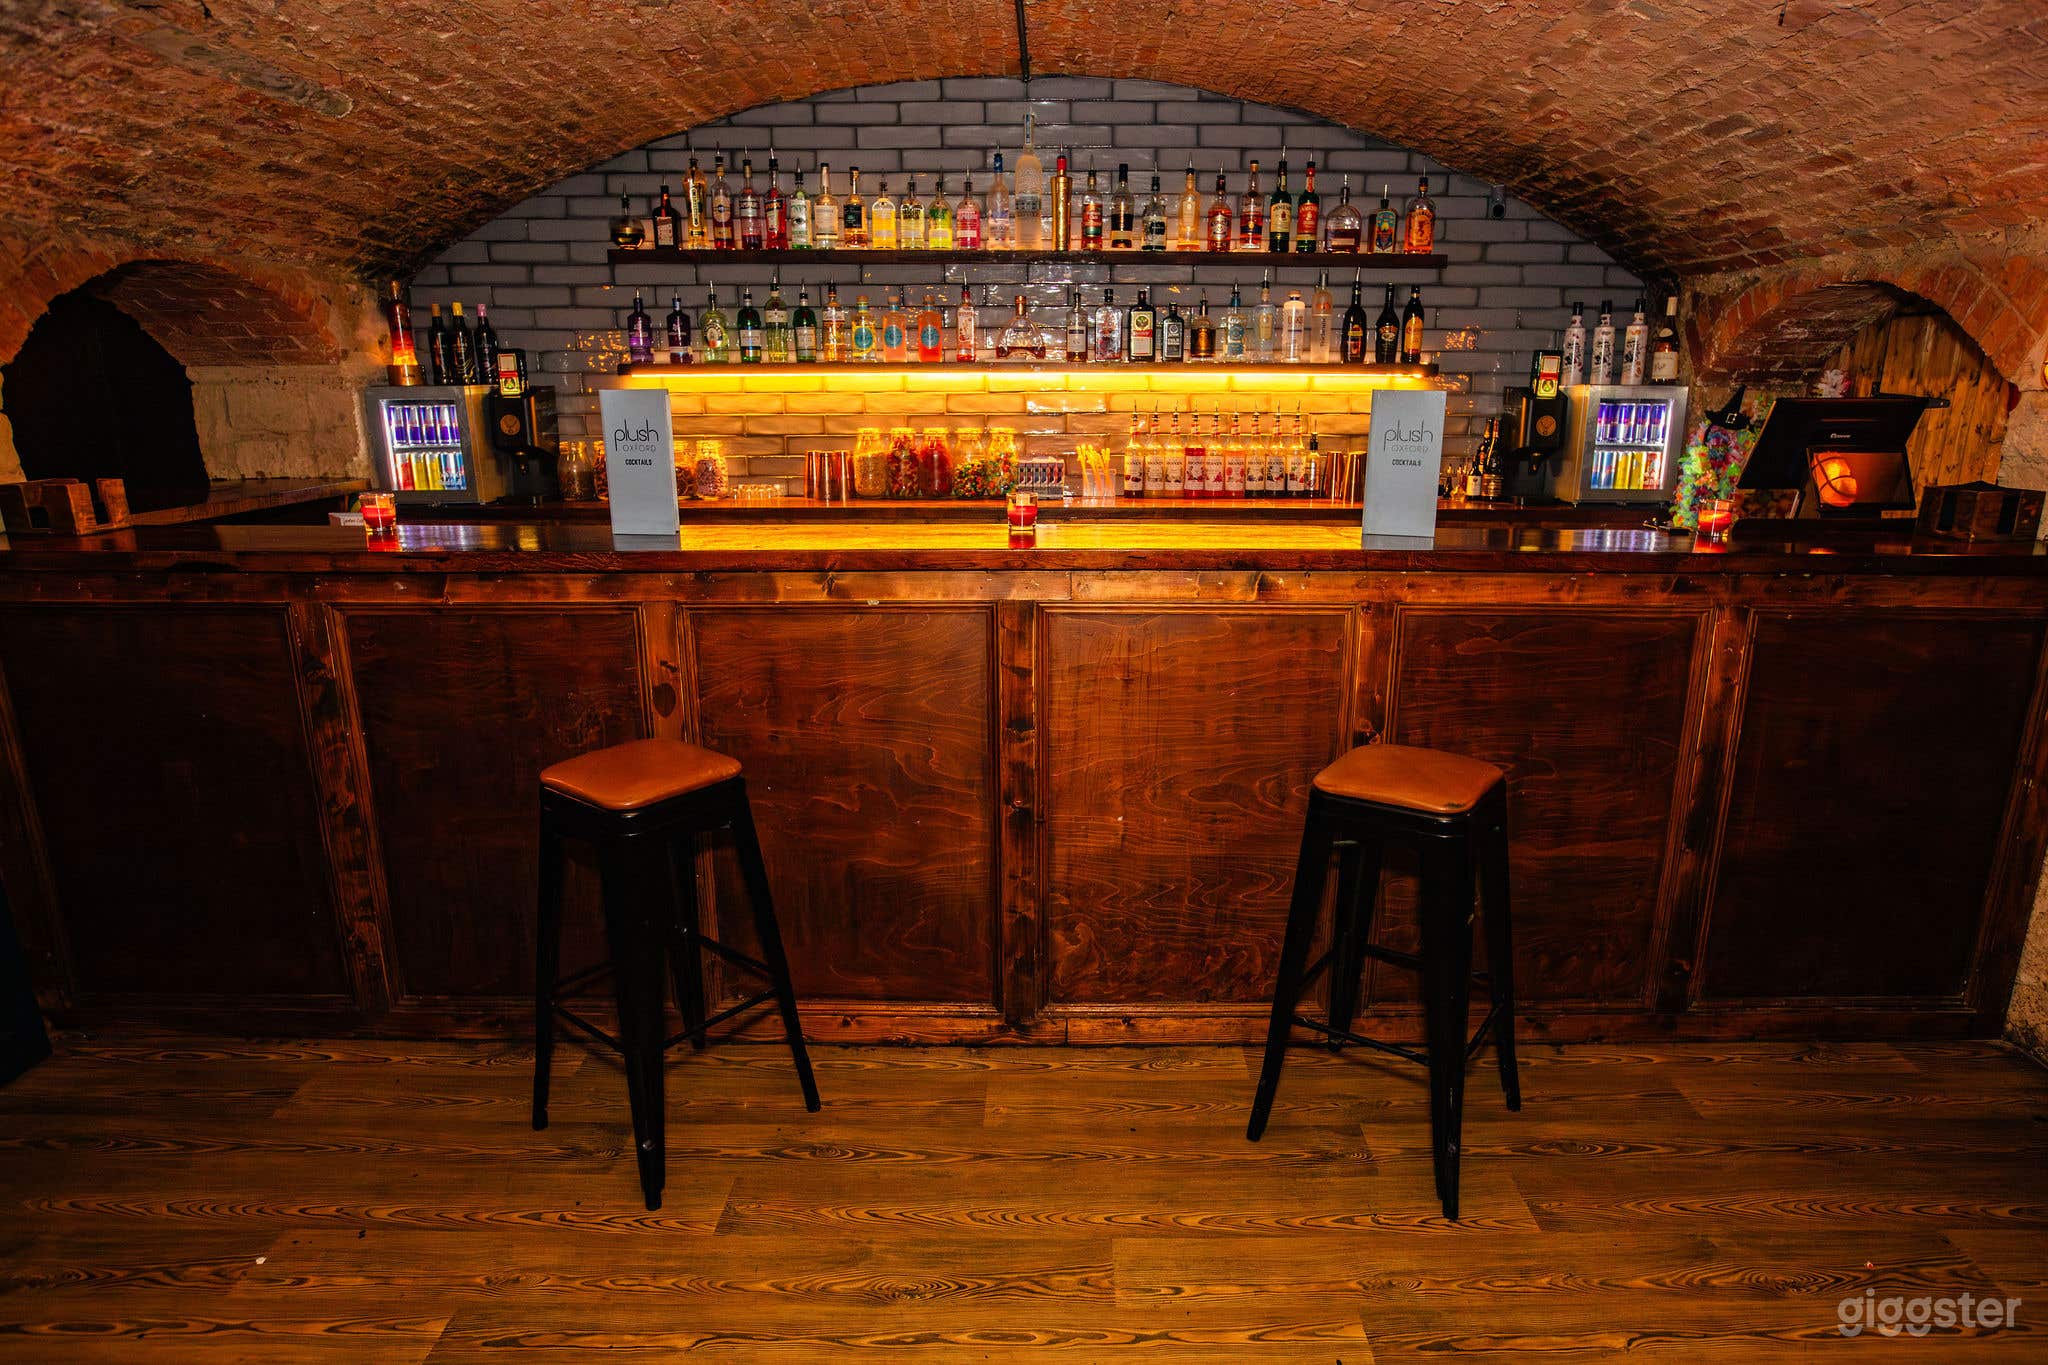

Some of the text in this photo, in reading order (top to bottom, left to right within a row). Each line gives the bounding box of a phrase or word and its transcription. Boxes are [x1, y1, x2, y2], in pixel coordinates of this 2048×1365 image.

[614, 419, 659, 451] plush
[1383, 419, 1433, 452] plush
[625, 458, 652, 466] COCKTAILS
[1392, 458, 1421, 466] COCKTAILS
